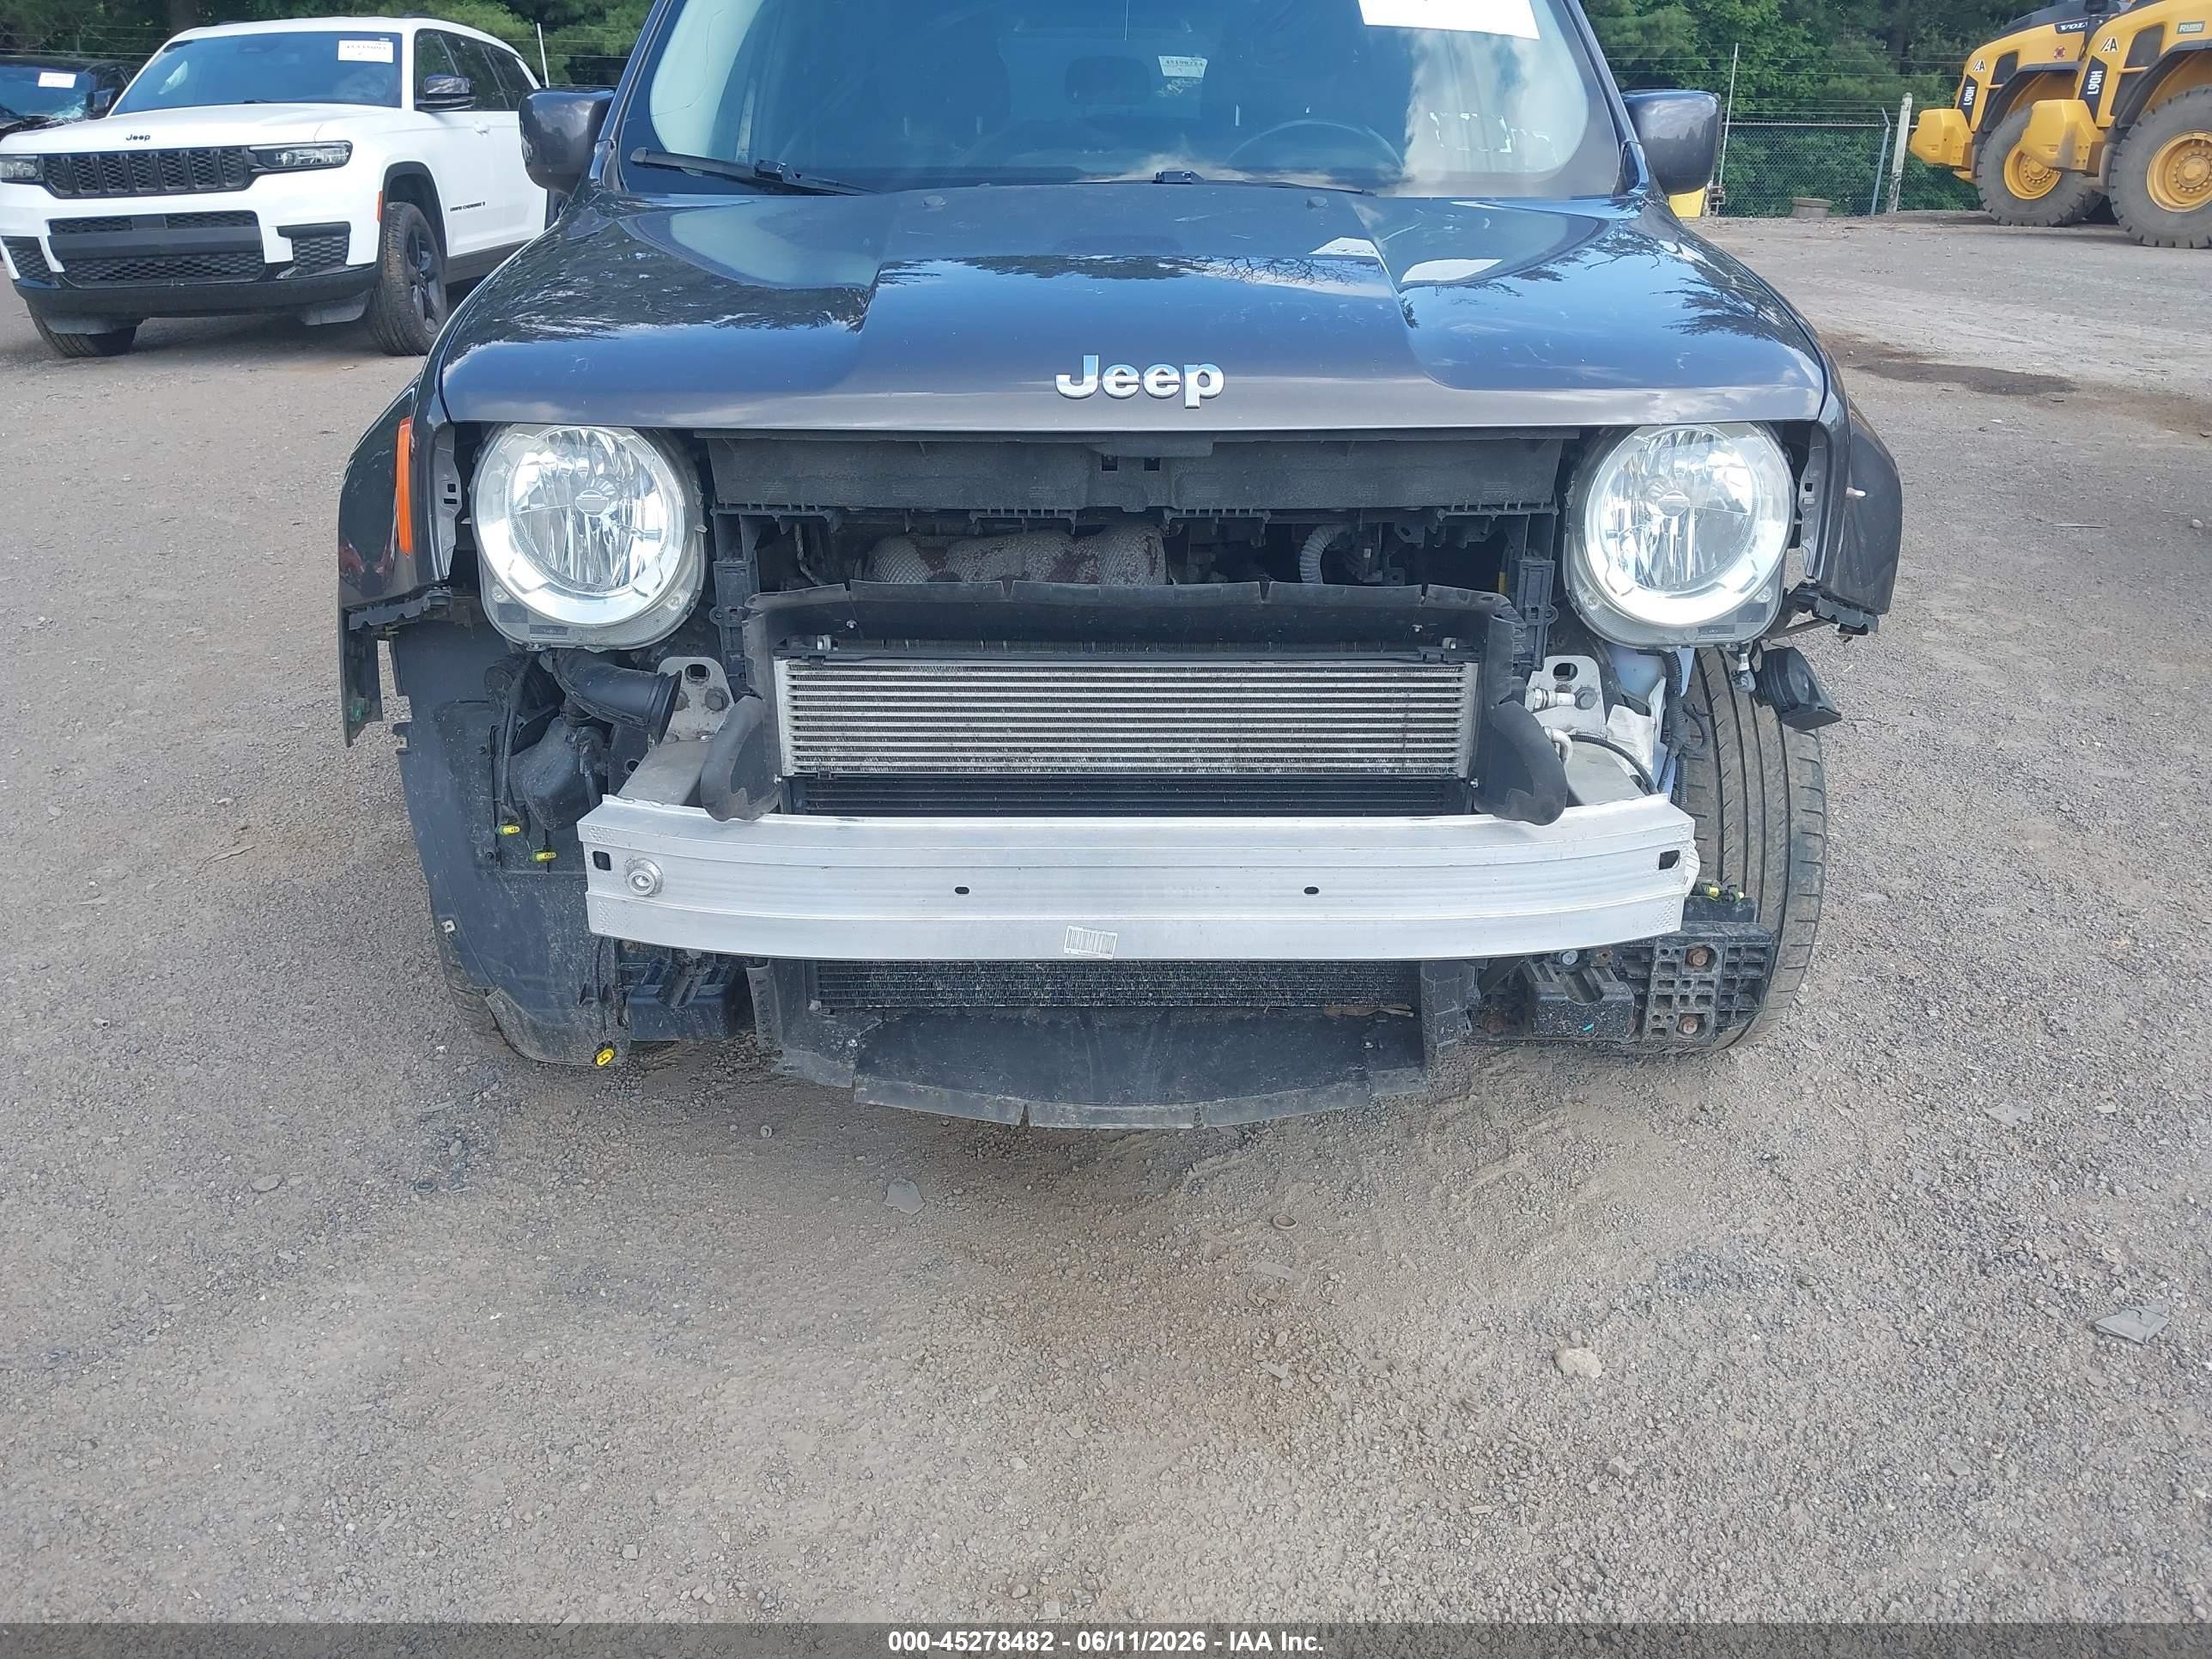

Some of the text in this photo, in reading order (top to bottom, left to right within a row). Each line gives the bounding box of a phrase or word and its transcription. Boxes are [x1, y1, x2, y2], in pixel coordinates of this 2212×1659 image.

[2087, 70, 2103, 95] L90H
[1963, 86, 1975, 106] L90H
[125, 133, 151, 142] Jeep
[1055, 354, 1224, 409] Jeep
